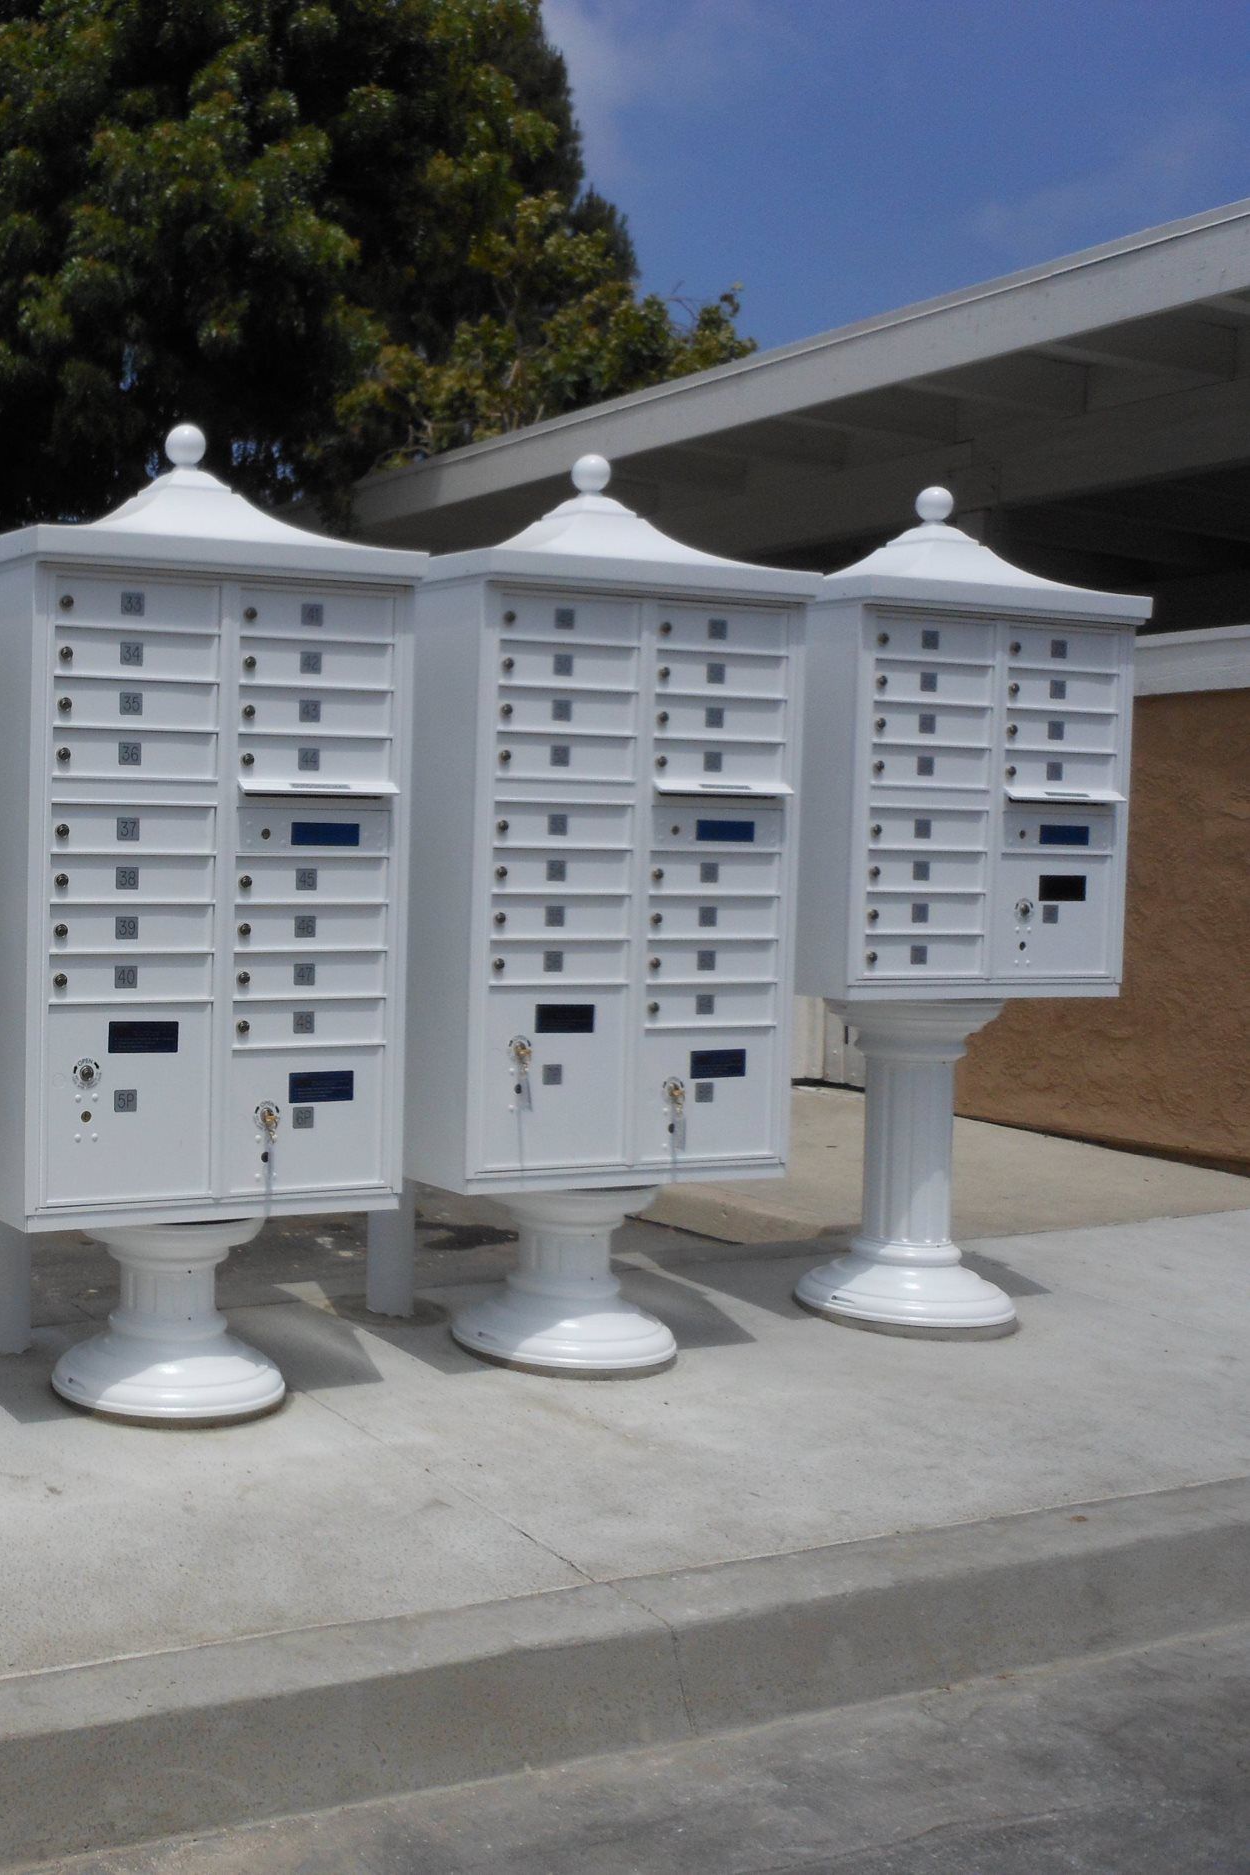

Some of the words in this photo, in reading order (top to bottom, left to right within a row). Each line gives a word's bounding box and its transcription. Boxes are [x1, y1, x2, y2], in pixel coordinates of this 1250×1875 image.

[125, 597, 141, 612] 33
[124, 646, 139, 661] 34
[124, 696, 140, 712] 35
[122, 746, 138, 761] 36
[121, 822, 136, 836] 37
[120, 871, 135, 886] 38
[119, 920, 135, 935] 39
[118, 969, 135, 984] 40
[118, 1094, 134, 1109] 5P
